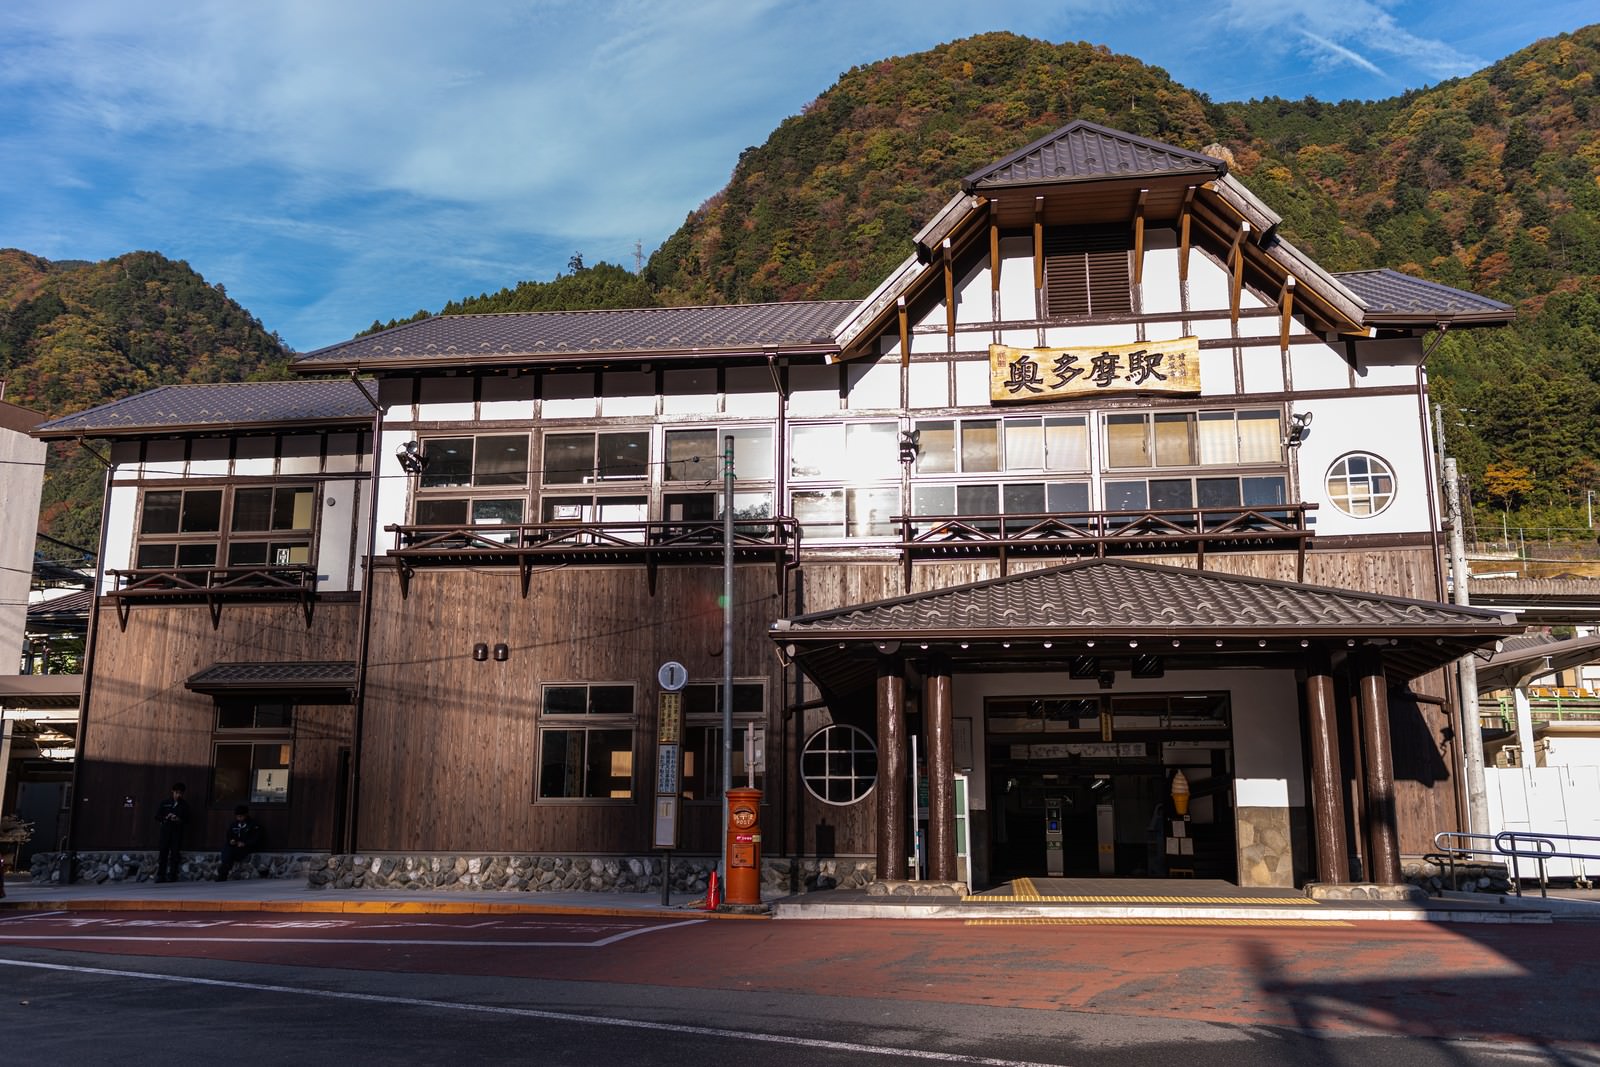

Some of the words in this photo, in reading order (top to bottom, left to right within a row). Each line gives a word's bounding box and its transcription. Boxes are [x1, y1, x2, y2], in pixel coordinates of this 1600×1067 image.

[1003, 349, 1167, 394] 奥多摩駅
[669, 666, 675, 685] 1
